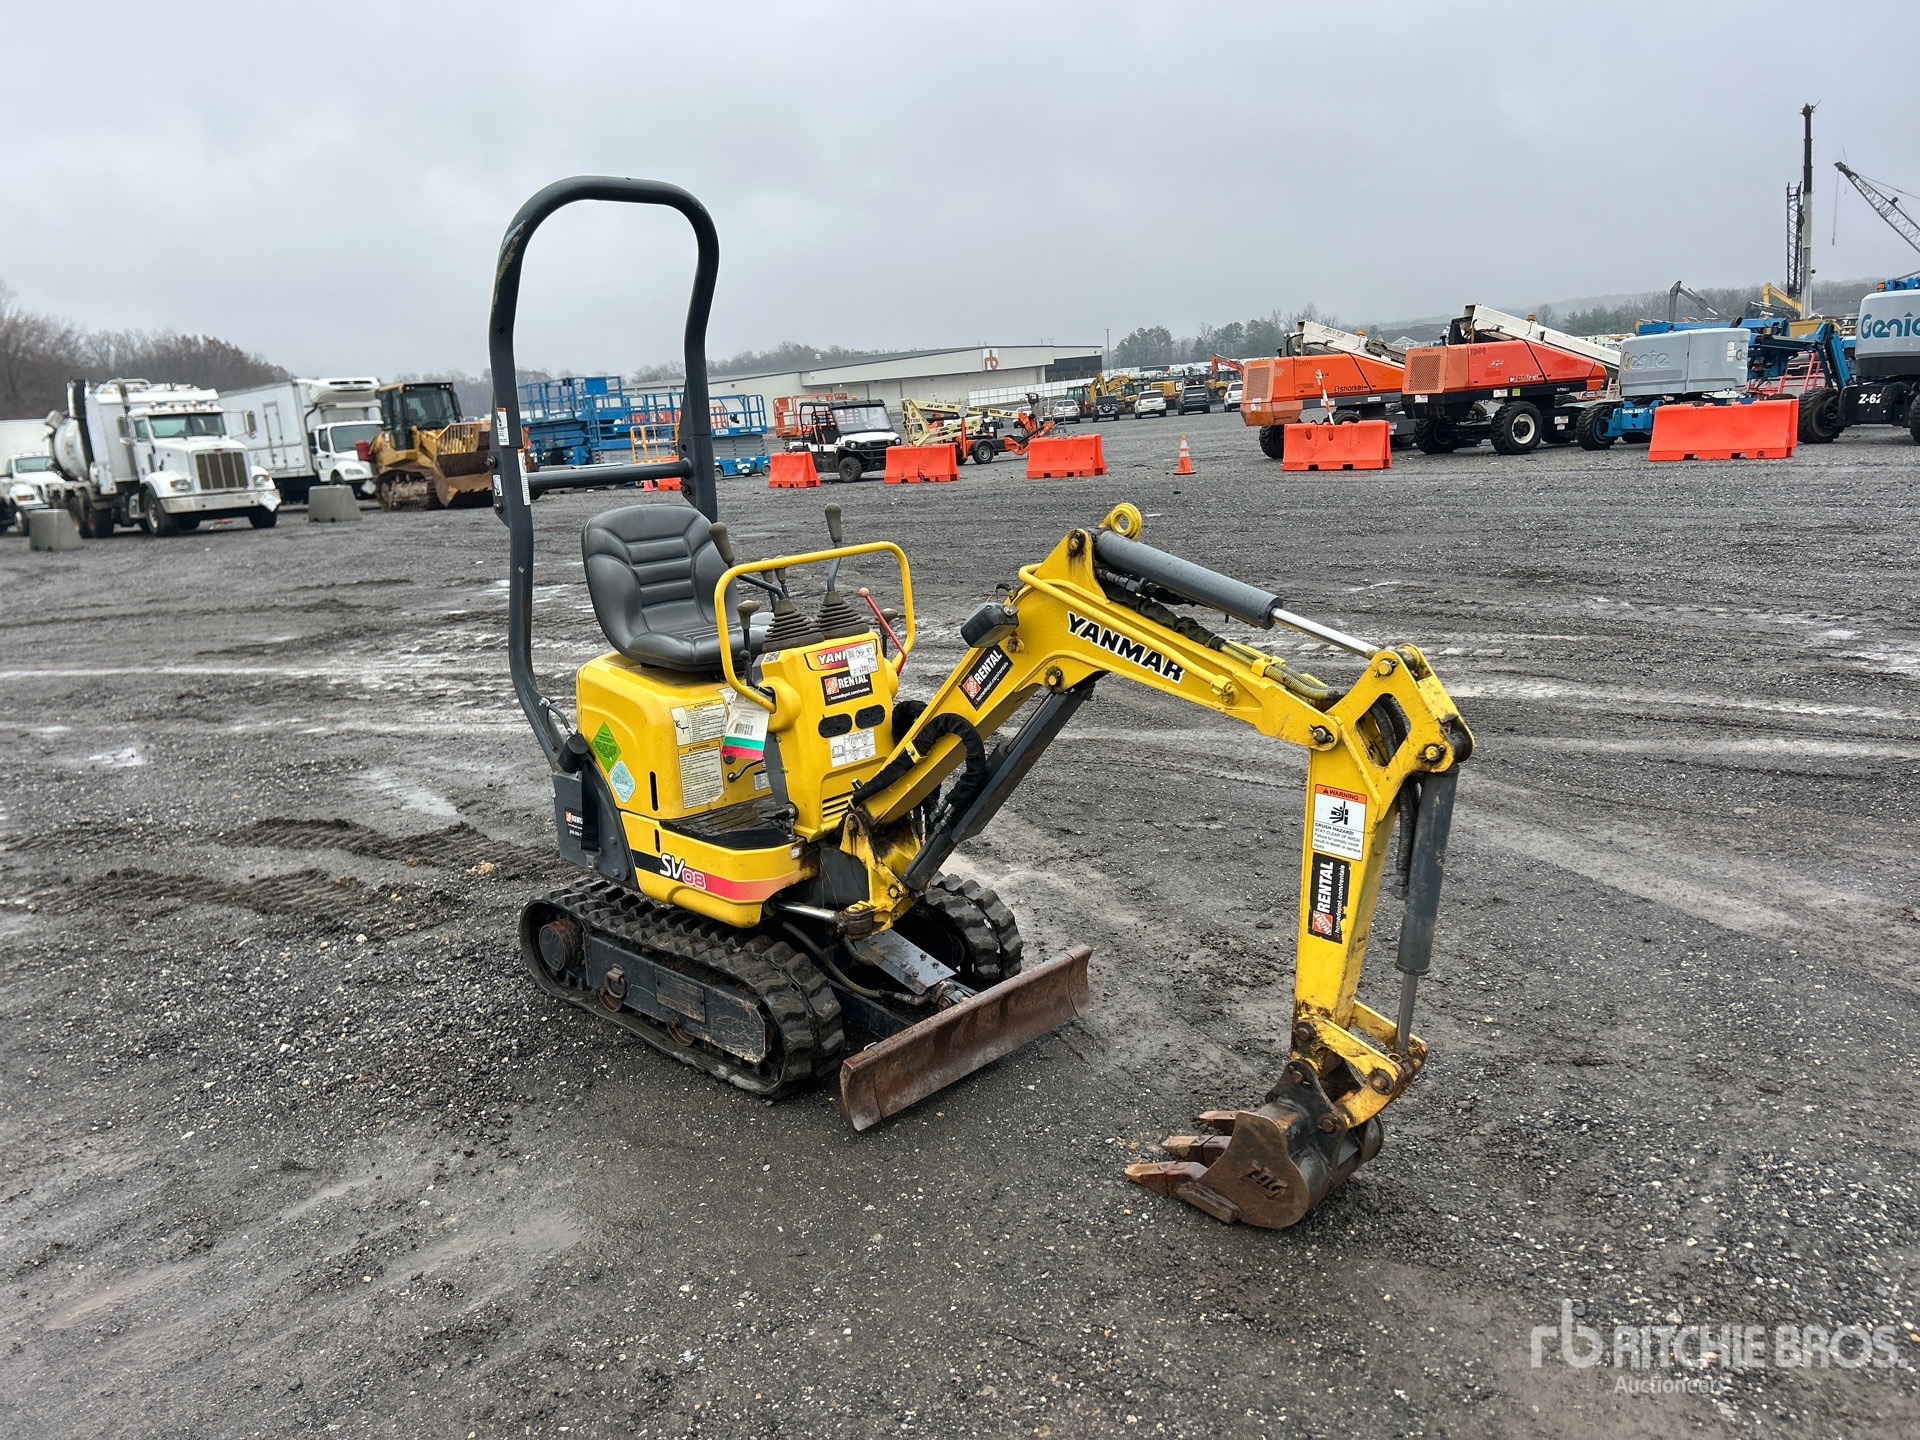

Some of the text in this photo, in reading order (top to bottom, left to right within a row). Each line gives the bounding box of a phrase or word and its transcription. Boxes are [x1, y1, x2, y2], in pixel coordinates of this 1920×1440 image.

[1067, 610, 1185, 684] YANMAR
[838, 674, 868, 689] RENTAL
[974, 650, 1002, 684] RENTAL
[1329, 789, 1359, 801] WARNING
[659, 853, 706, 890] SV08
[1317, 861, 1334, 913] RENTAL
